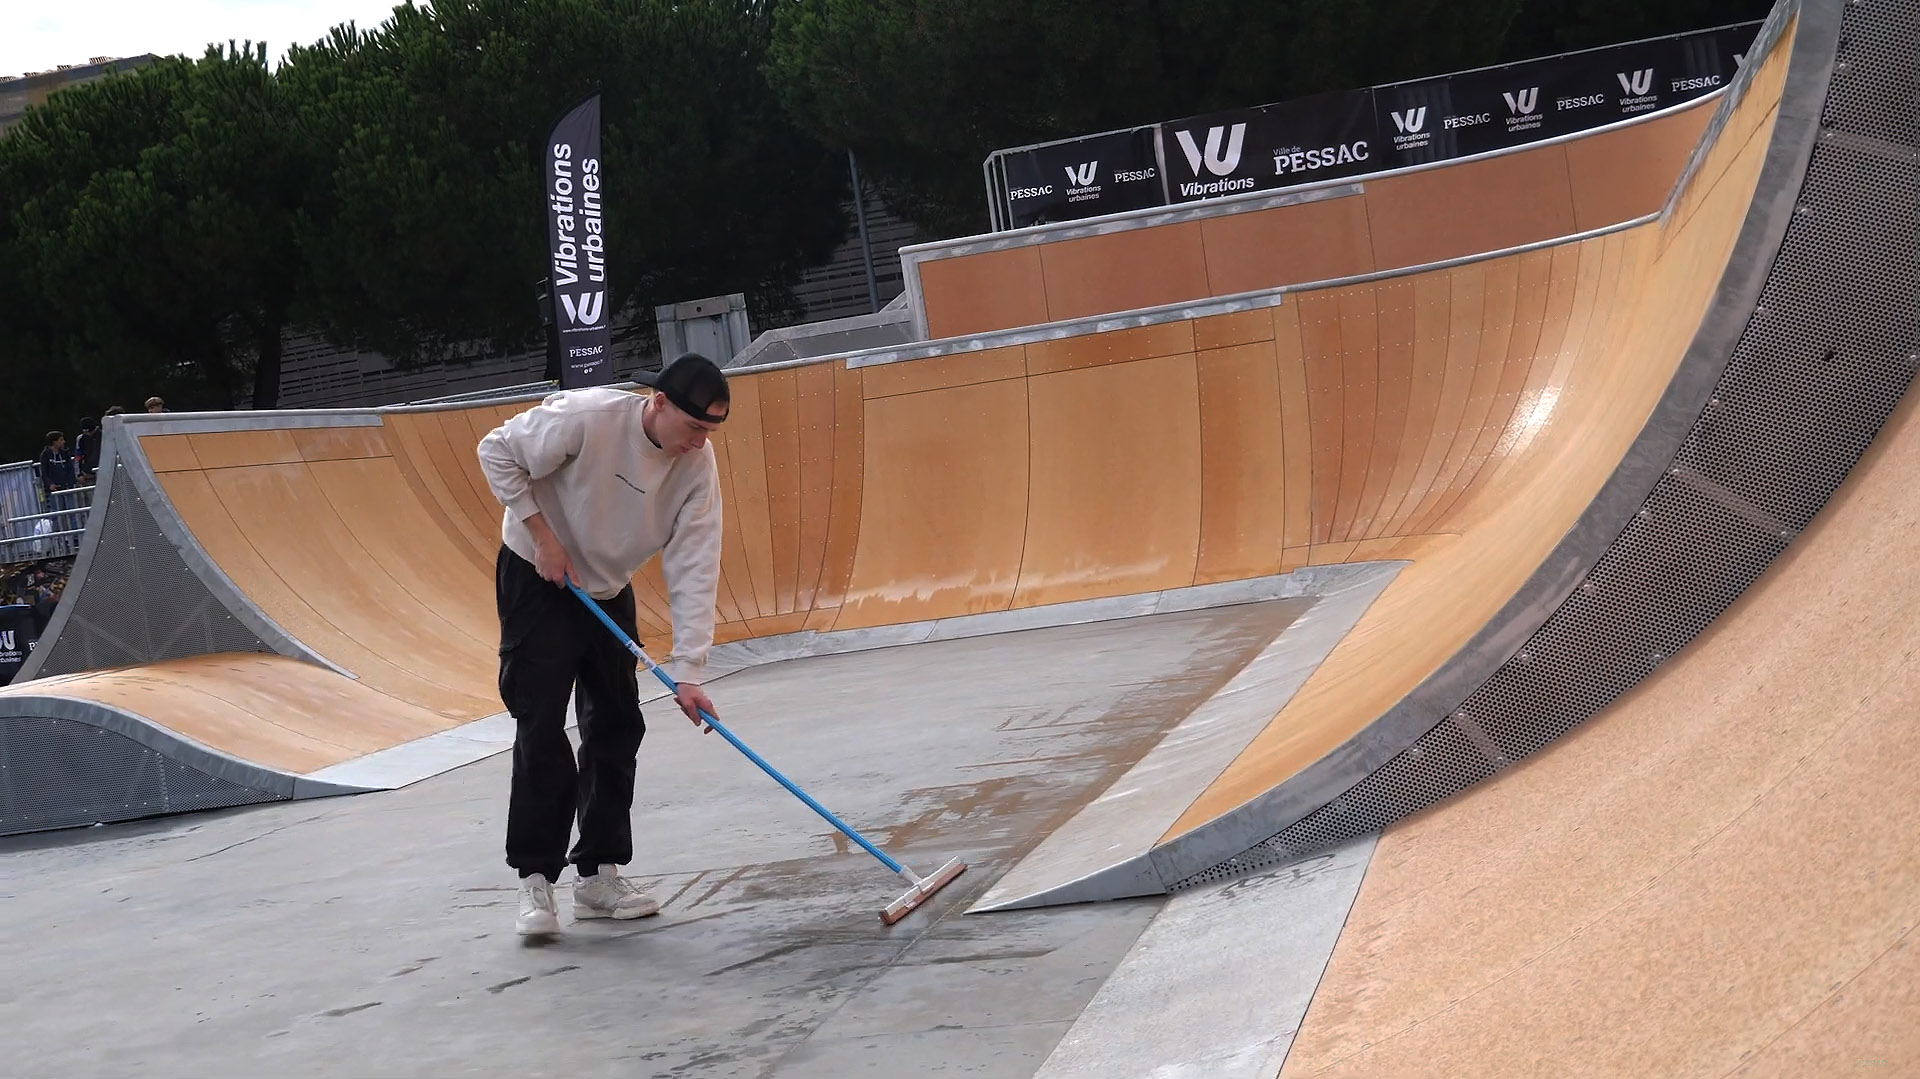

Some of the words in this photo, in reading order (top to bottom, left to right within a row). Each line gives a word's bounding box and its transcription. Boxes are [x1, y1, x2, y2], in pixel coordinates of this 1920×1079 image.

[1671, 75, 1720, 92] PESSAC
[1556, 93, 1604, 111] PESSAC
[1619, 95, 1658, 106] Vibrations
[1622, 103, 1656, 113] urbaines
[1443, 113, 1491, 130] PESSAC
[1505, 113, 1543, 125] Vibrations
[1508, 122, 1541, 132] urbaines
[1393, 131, 1431, 143] Vibrations
[1273, 147, 1290, 157] Ville
[1290, 145, 1301, 154] de
[1396, 140, 1429, 151] urbaines
[1273, 141, 1369, 176] PESSAC
[1114, 167, 1156, 183] PESSAC
[1010, 185, 1053, 201] PESSAC
[1066, 185, 1102, 196] Vibrations
[1180, 177, 1255, 197] Vibrations
[1068, 193, 1100, 203] urbaines
[551, 143, 579, 286] Vibrations
[578, 158, 604, 282] urbaines
[569, 345, 603, 358] PESSAC
